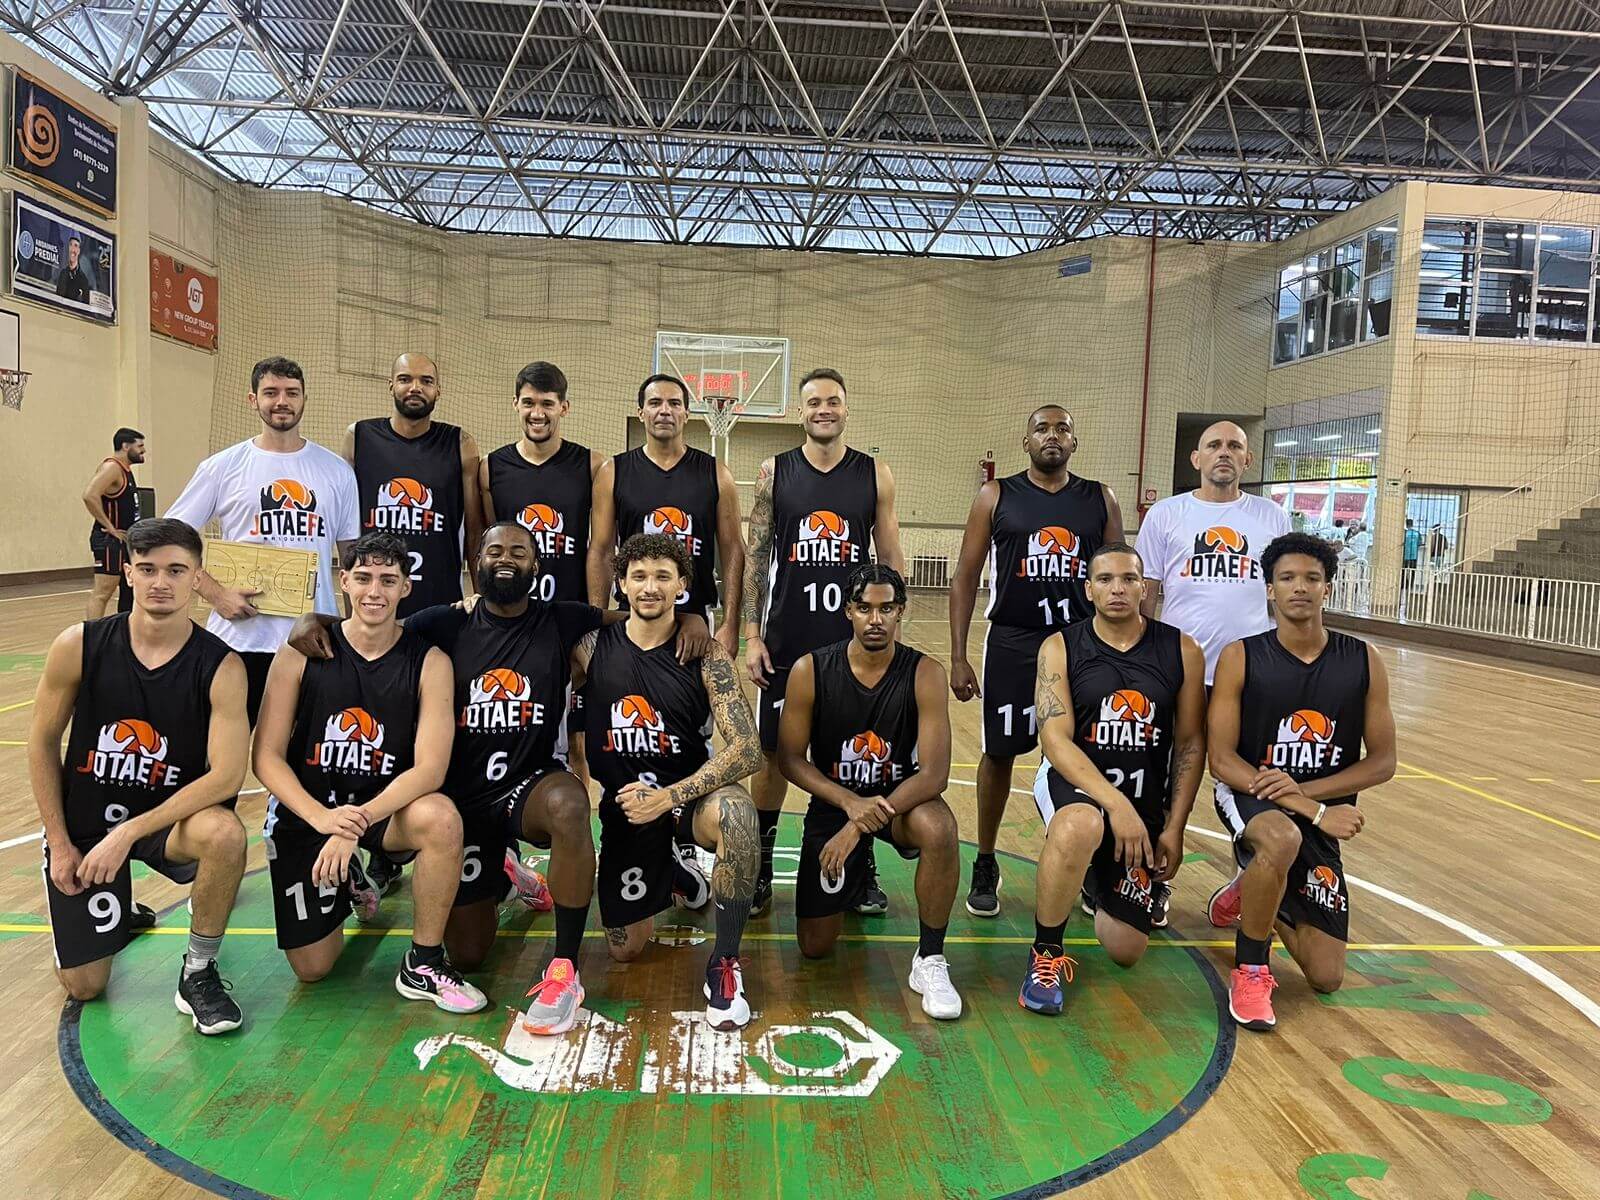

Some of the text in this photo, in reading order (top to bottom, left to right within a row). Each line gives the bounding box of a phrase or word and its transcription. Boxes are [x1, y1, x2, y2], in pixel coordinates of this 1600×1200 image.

[34, 246, 60, 264] PREDIAL
[250, 511, 326, 537] JOTAEFE
[364, 506, 444, 532] JOTAEFE
[535, 531, 576, 554] AEFE
[788, 539, 860, 563] JOTAEFE
[1016, 554, 1088, 579] JOTAEFE
[1180, 554, 1259, 580] JOTAEFE
[803, 582, 842, 612] 10
[1038, 597, 1071, 626] 11
[457, 701, 545, 728] JOTAEFE
[998, 703, 1036, 737] 11
[602, 727, 681, 755] JOTAEFE
[1084, 721, 1162, 747] JOTAEFE
[76, 750, 182, 786] JOTAEFE
[306, 741, 396, 776] JOTAEFE
[486, 751, 508, 781] 6
[829, 760, 904, 784] JOTAEFE
[461, 845, 482, 883] 6
[620, 866, 648, 902] 8
[87, 891, 122, 934] 9
[285, 881, 337, 921] 15
